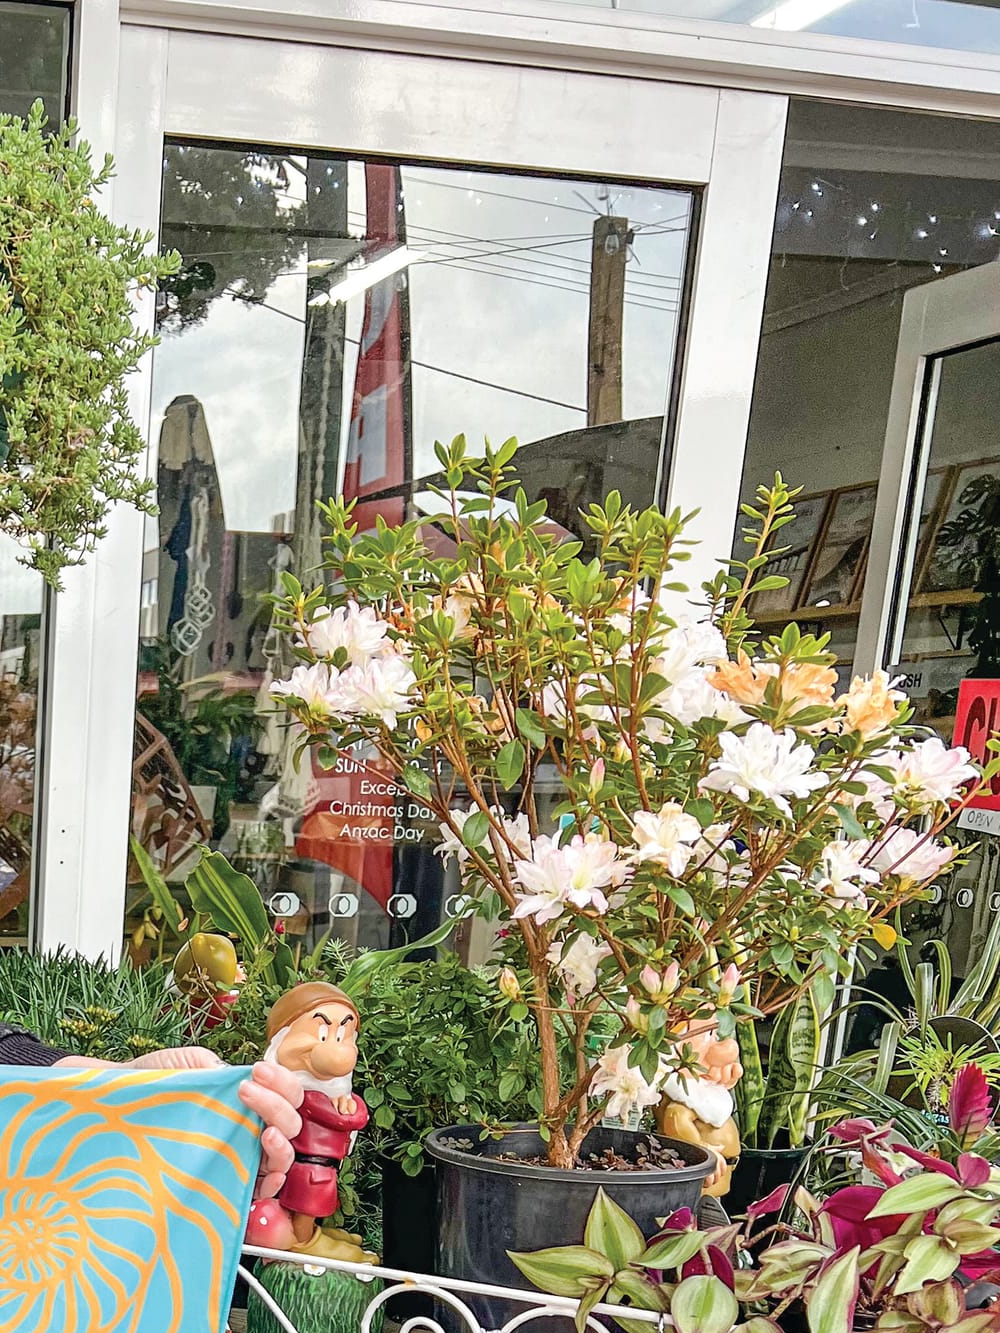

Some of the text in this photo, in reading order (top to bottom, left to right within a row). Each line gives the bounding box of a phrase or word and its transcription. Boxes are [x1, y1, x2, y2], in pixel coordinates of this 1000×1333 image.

[335, 758, 367, 773] SUN
[360, 780, 411, 797] Excep
[330, 800, 437, 821] Christmas Day
[340, 824, 425, 842] Anzac Day
